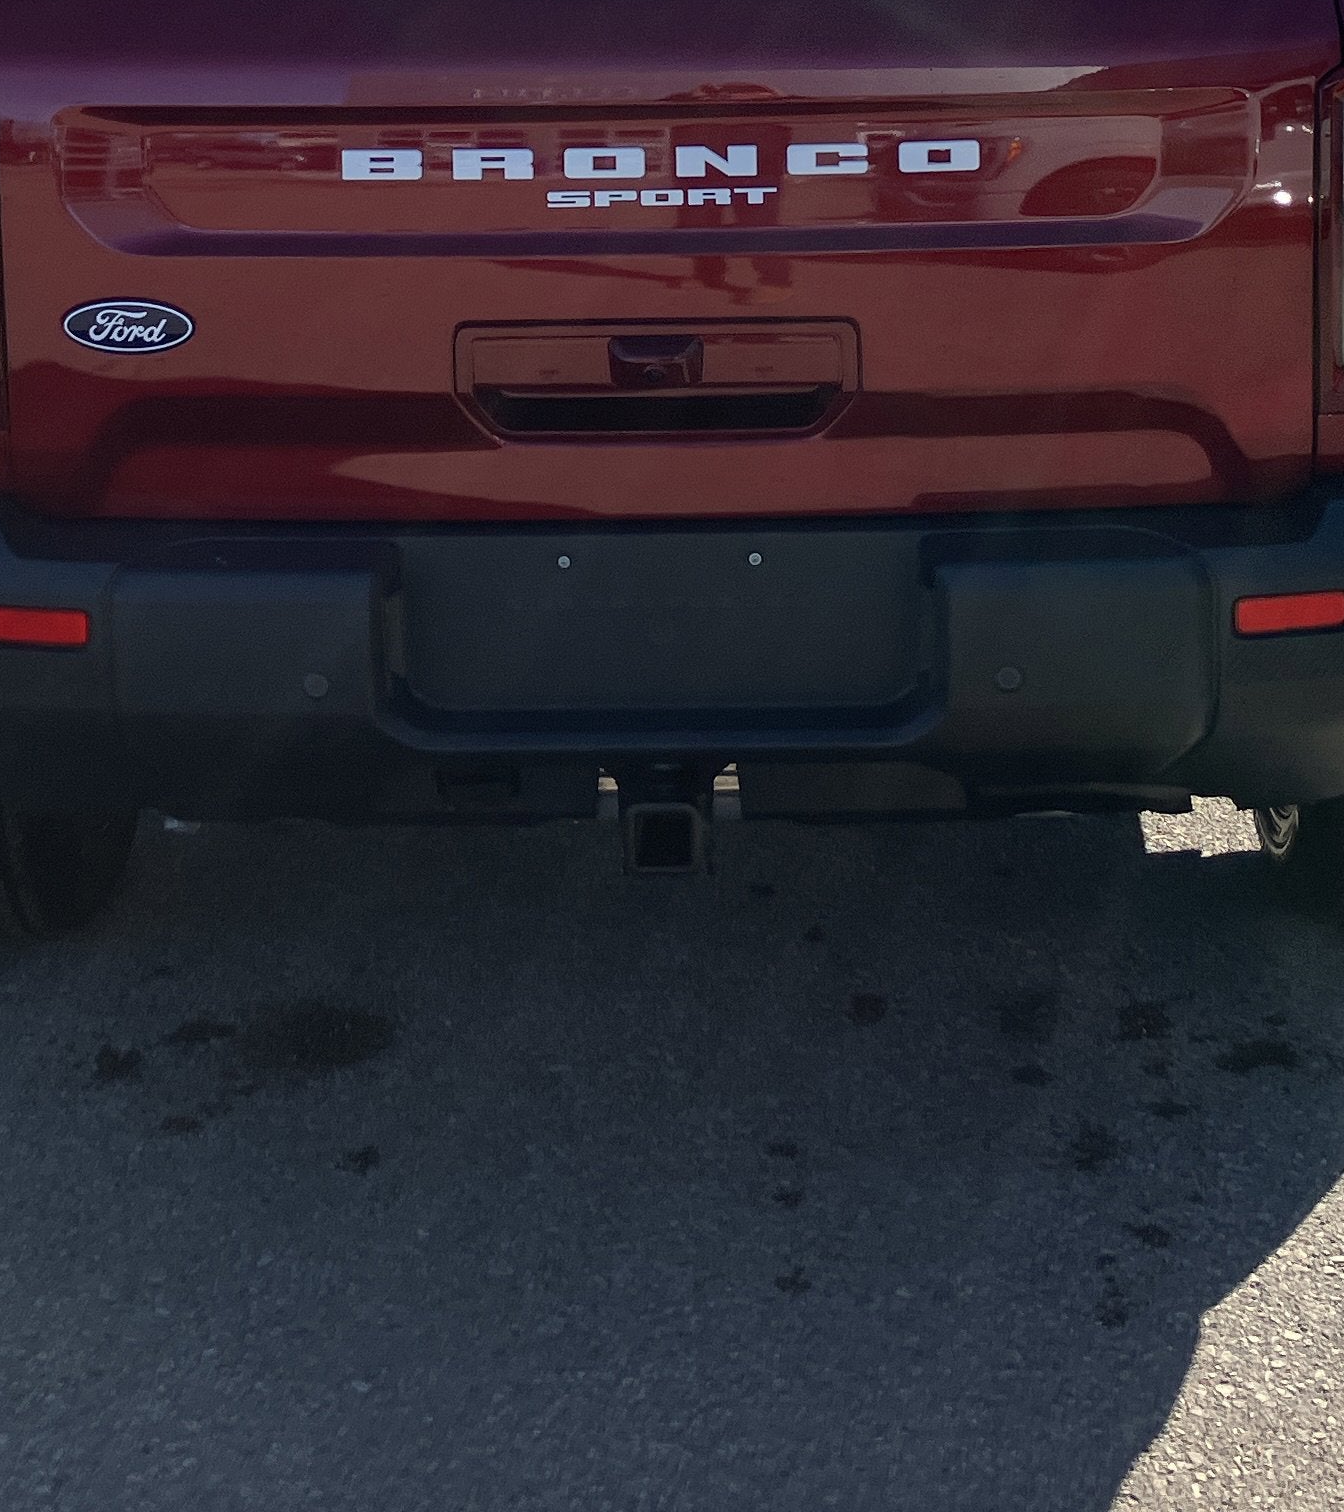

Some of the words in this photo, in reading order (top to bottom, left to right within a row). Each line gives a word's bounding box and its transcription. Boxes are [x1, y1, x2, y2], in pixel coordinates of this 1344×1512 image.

[341, 140, 981, 181] BRONCO
[546, 187, 778, 208] SPORT
[88, 309, 167, 343] Ford
